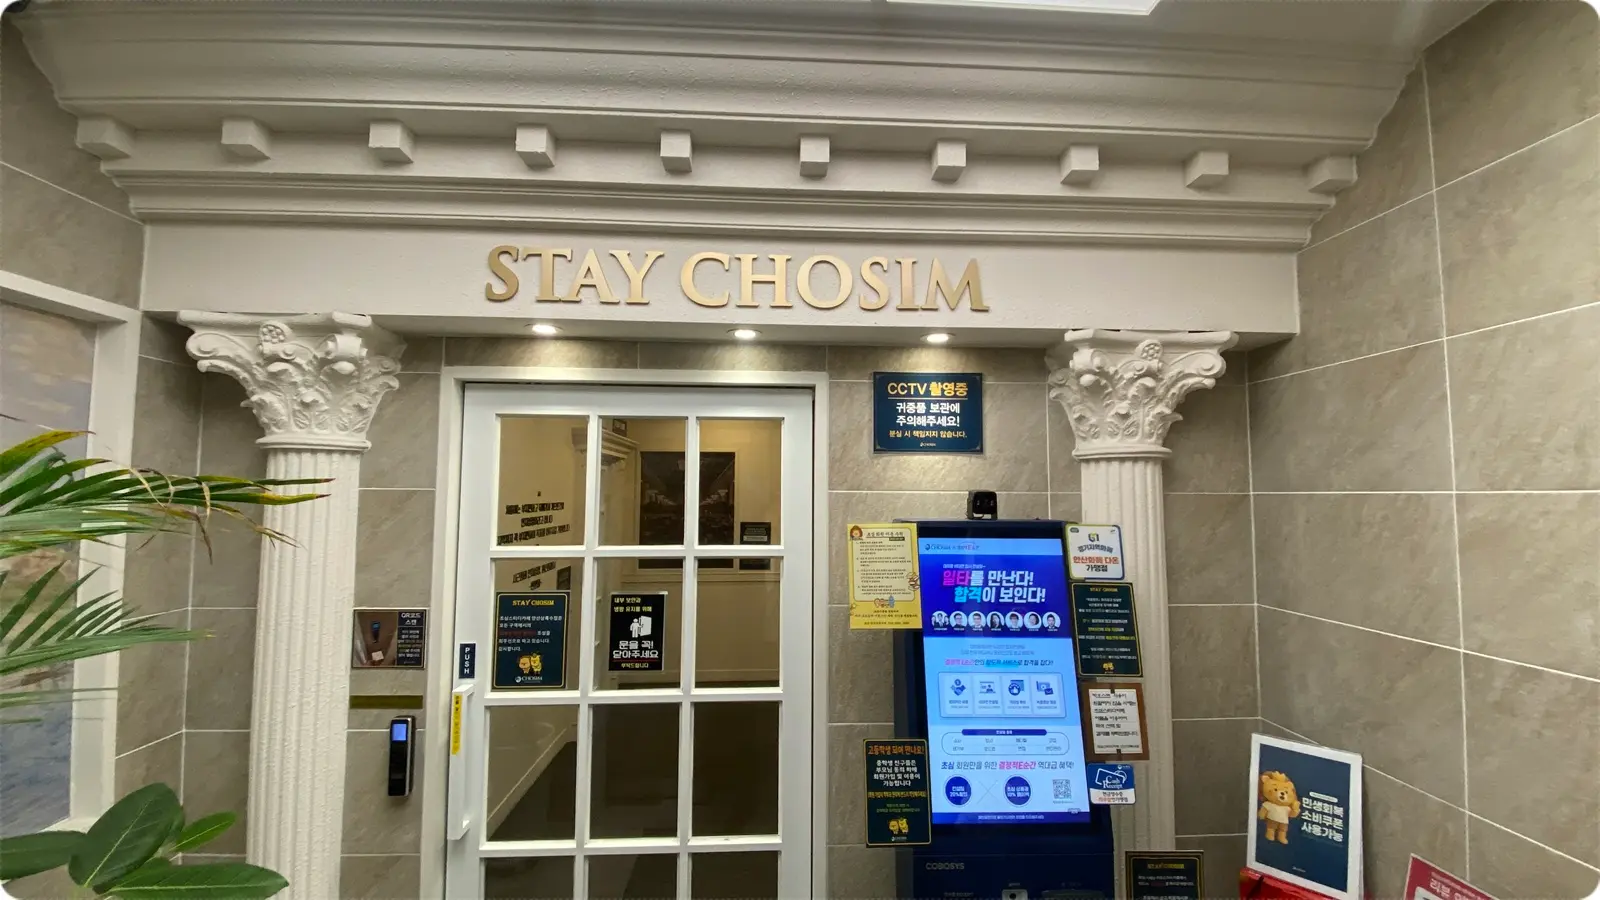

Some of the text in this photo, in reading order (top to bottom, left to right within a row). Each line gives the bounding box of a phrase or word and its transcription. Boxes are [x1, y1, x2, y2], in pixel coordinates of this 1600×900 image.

[485, 245, 990, 313] STAY CHOSIM
[887, 382, 968, 396] CCTV 촬영중
[896, 402, 960, 414] 귀중품 보관에
[896, 415, 960, 427] 주의해주세요!
[889, 430, 902, 438] 분실
[904, 430, 911, 438] 시
[913, 430, 938, 438] 책임지지
[943, 570, 1034, 587] 일타를 만난다!
[954, 587, 1046, 604] 합격이 보인다!
[619, 640, 654, 650] 문을 꼭!
[613, 650, 659, 659] 닫아주세요
[868, 745, 891, 755] 고등학생
[941, 761, 955, 770] 초심
[956, 761, 982, 770] 회원만을
[984, 761, 997, 770] 위한
[1038, 761, 1057, 769] 역대급
[1301, 797, 1344, 818] 민생회복
[1301, 810, 1344, 830] 소비쿠폰
[1301, 821, 1344, 842] 사용가능
